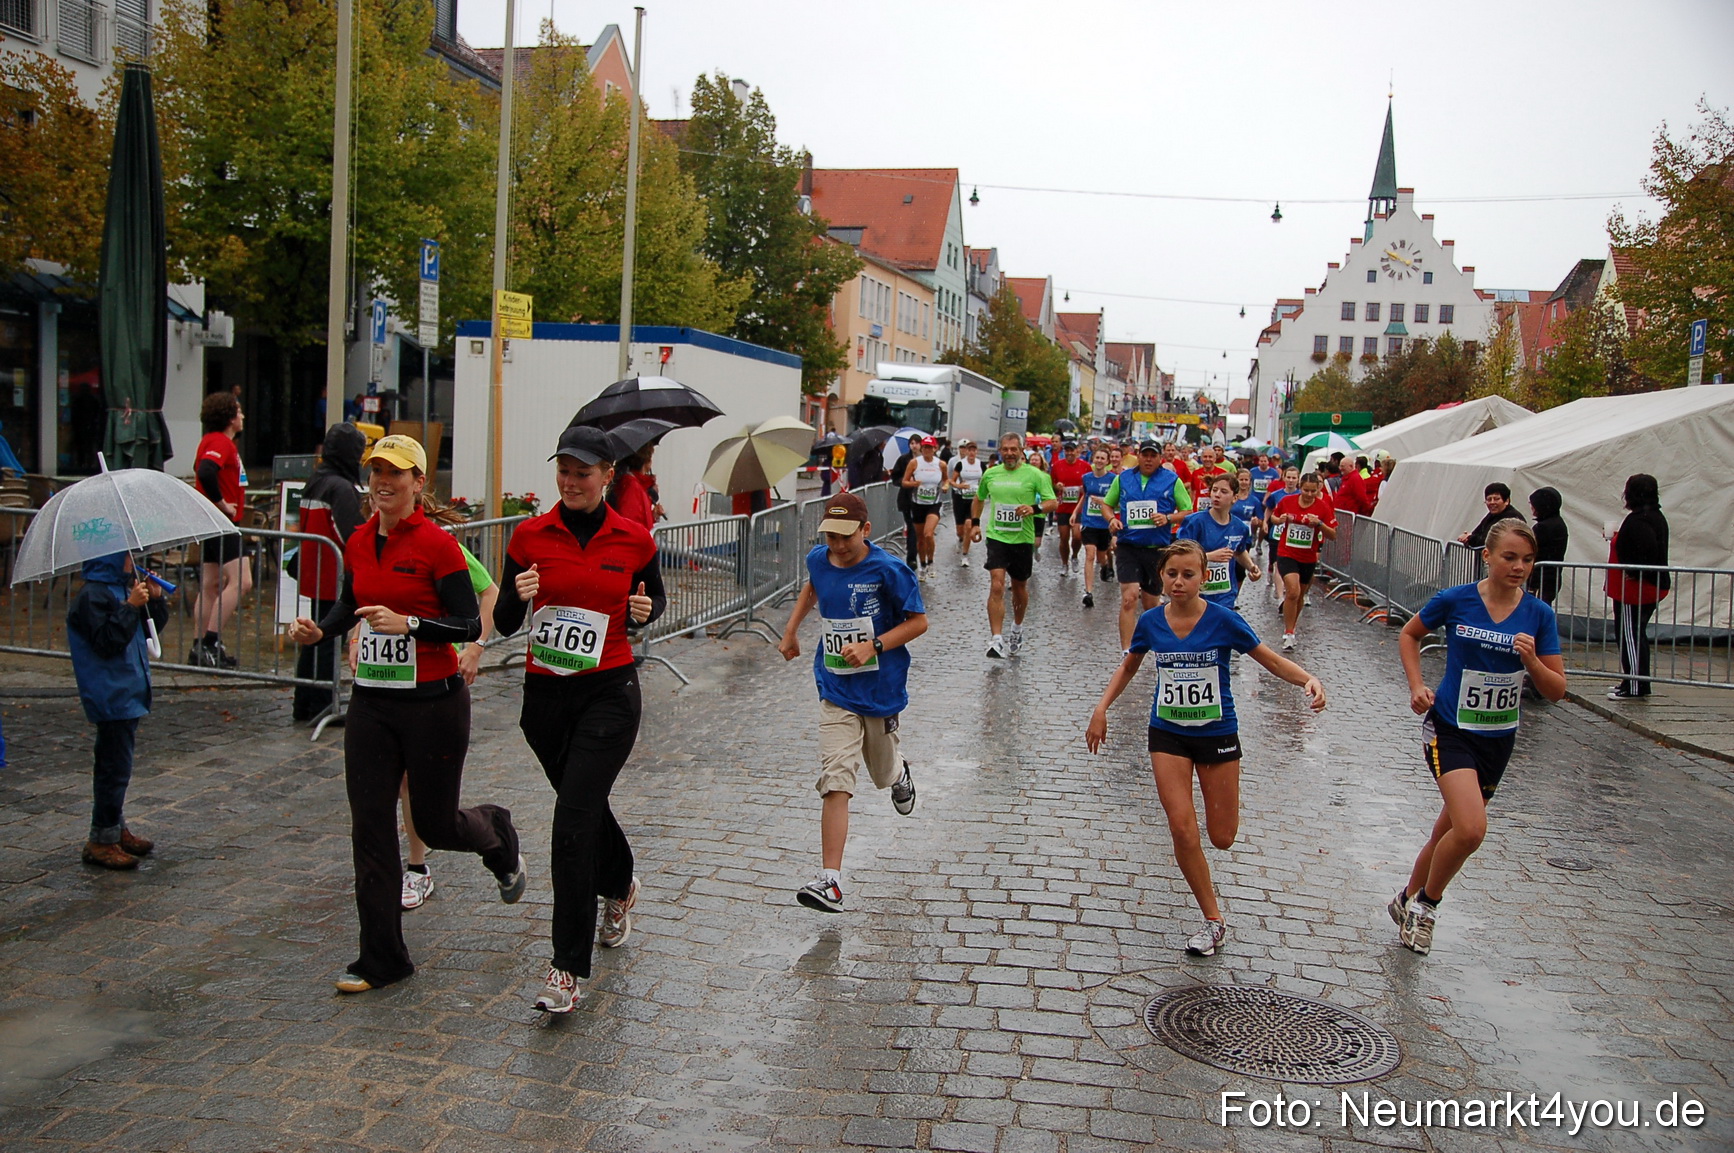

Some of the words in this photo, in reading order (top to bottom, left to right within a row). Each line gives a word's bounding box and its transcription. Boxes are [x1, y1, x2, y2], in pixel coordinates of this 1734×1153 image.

[374, 305, 385, 339] P
[1693, 325, 1703, 352] P
[1129, 507, 1154, 520] 5158
[1289, 529, 1311, 540] 5185
[1207, 567, 1227, 582] 066
[535, 621, 597, 655] 5169
[361, 637, 409, 663] 5148
[538, 649, 584, 669] Alexandra
[367, 667, 396, 679] Carolin
[1163, 682, 1214, 706] 5164
[1466, 686, 1519, 710] 5165
[1170, 709, 1207, 718] Manuela
[1474, 712, 1509, 723] Theresa
